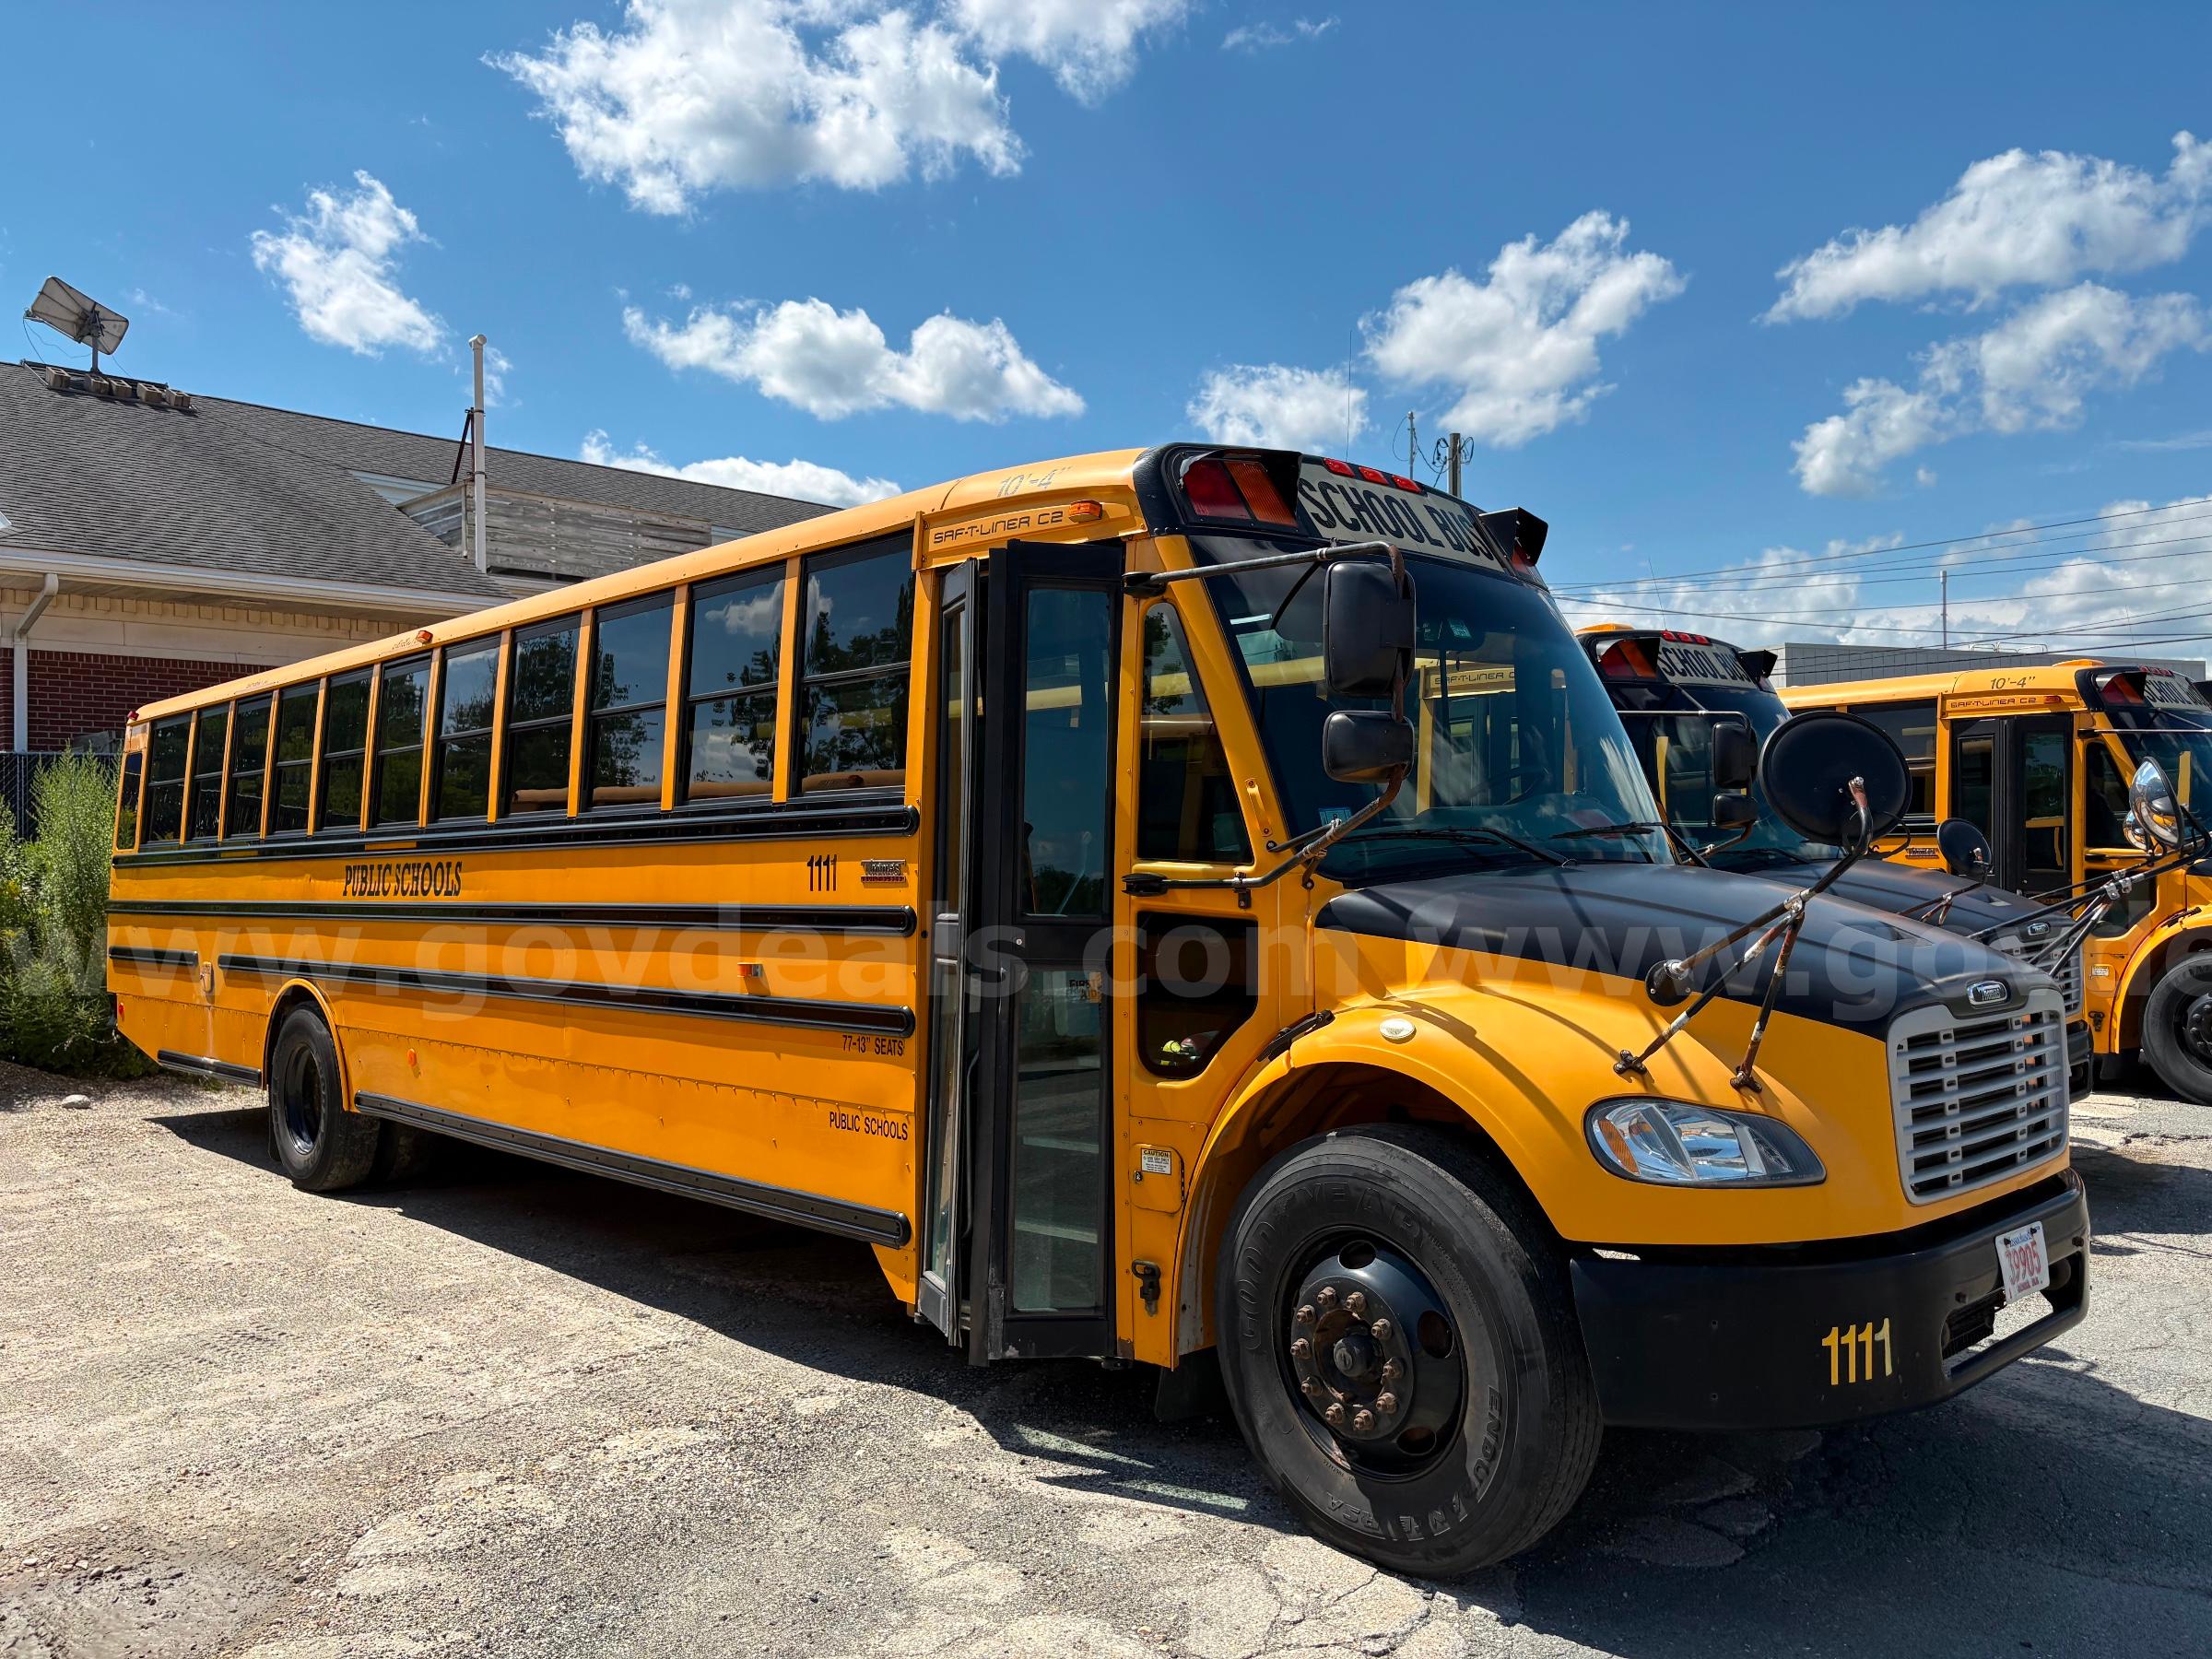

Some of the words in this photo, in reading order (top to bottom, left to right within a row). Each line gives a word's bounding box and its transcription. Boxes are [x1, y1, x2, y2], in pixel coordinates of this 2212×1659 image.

[1038, 511, 1064, 525] C2
[1298, 477, 1445, 548] SCHOOL
[1424, 504, 1495, 561] BUS
[1658, 647, 1728, 680] SCHOOL
[1713, 652, 1752, 682] BUS
[2144, 679, 2193, 705] SCHOOL
[343, 864, 393, 897] PUBLIC
[394, 861, 463, 897] SCHOOLS
[806, 853, 838, 892] 1111
[874, 1037, 904, 1057] SEATS
[830, 1111, 861, 1133] PUBLIC
[864, 1116, 908, 1141] SCHOOLS
[1821, 1317, 1893, 1386] 1111
